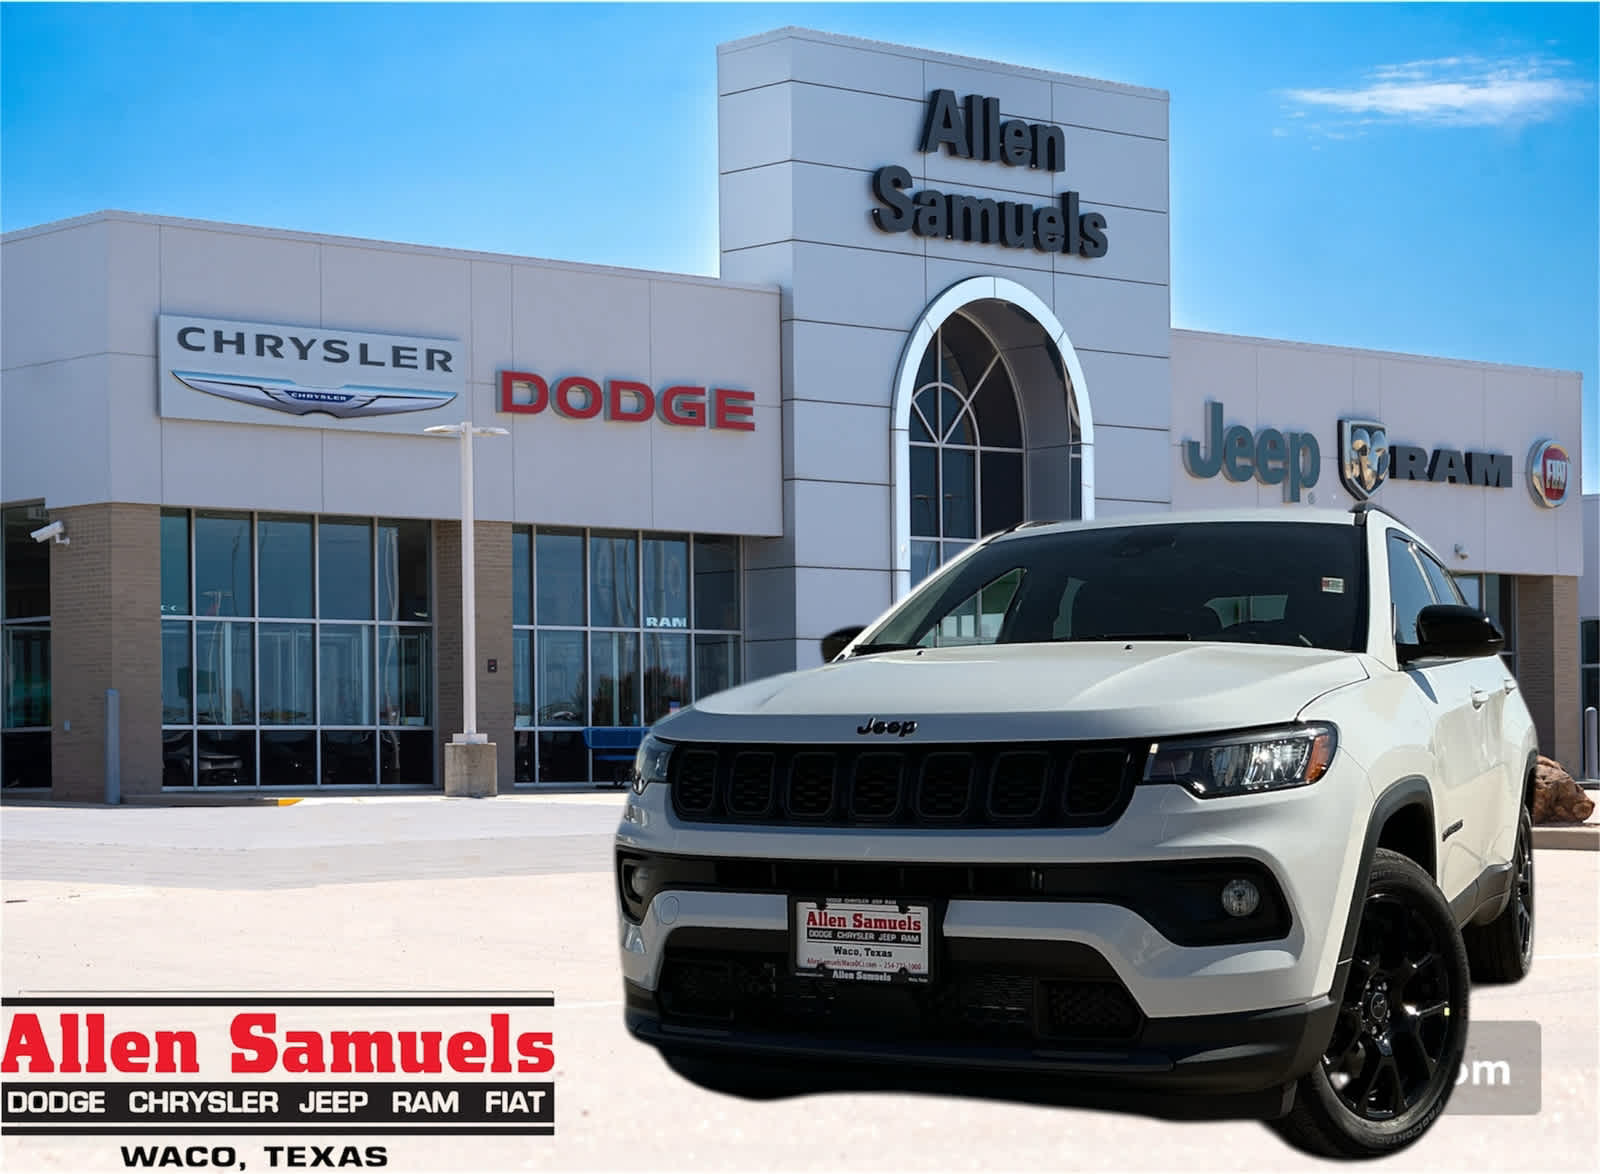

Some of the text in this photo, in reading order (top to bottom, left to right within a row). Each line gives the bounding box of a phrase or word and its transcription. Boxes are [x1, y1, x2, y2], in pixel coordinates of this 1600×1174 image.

[918, 88, 1066, 173] Allen
[871, 165, 1108, 258] Samuels
[177, 326, 454, 373] CHRYSLER
[291, 391, 347, 401] CHRYSLER
[495, 369, 756, 432] DODGE
[1182, 399, 1321, 503] Jeep
[1389, 445, 1513, 488] RAM
[645, 616, 687, 628] RAM
[856, 717, 918, 738] Jeep
[806, 911, 922, 931] Allen Samuels
[808, 929, 920, 943] DODGE CHRYSLER JEEP RAM
[833, 946, 893, 958] Waco, Texas
[832, 970, 855, 979] Allen
[856, 972, 892, 982] Samuels
